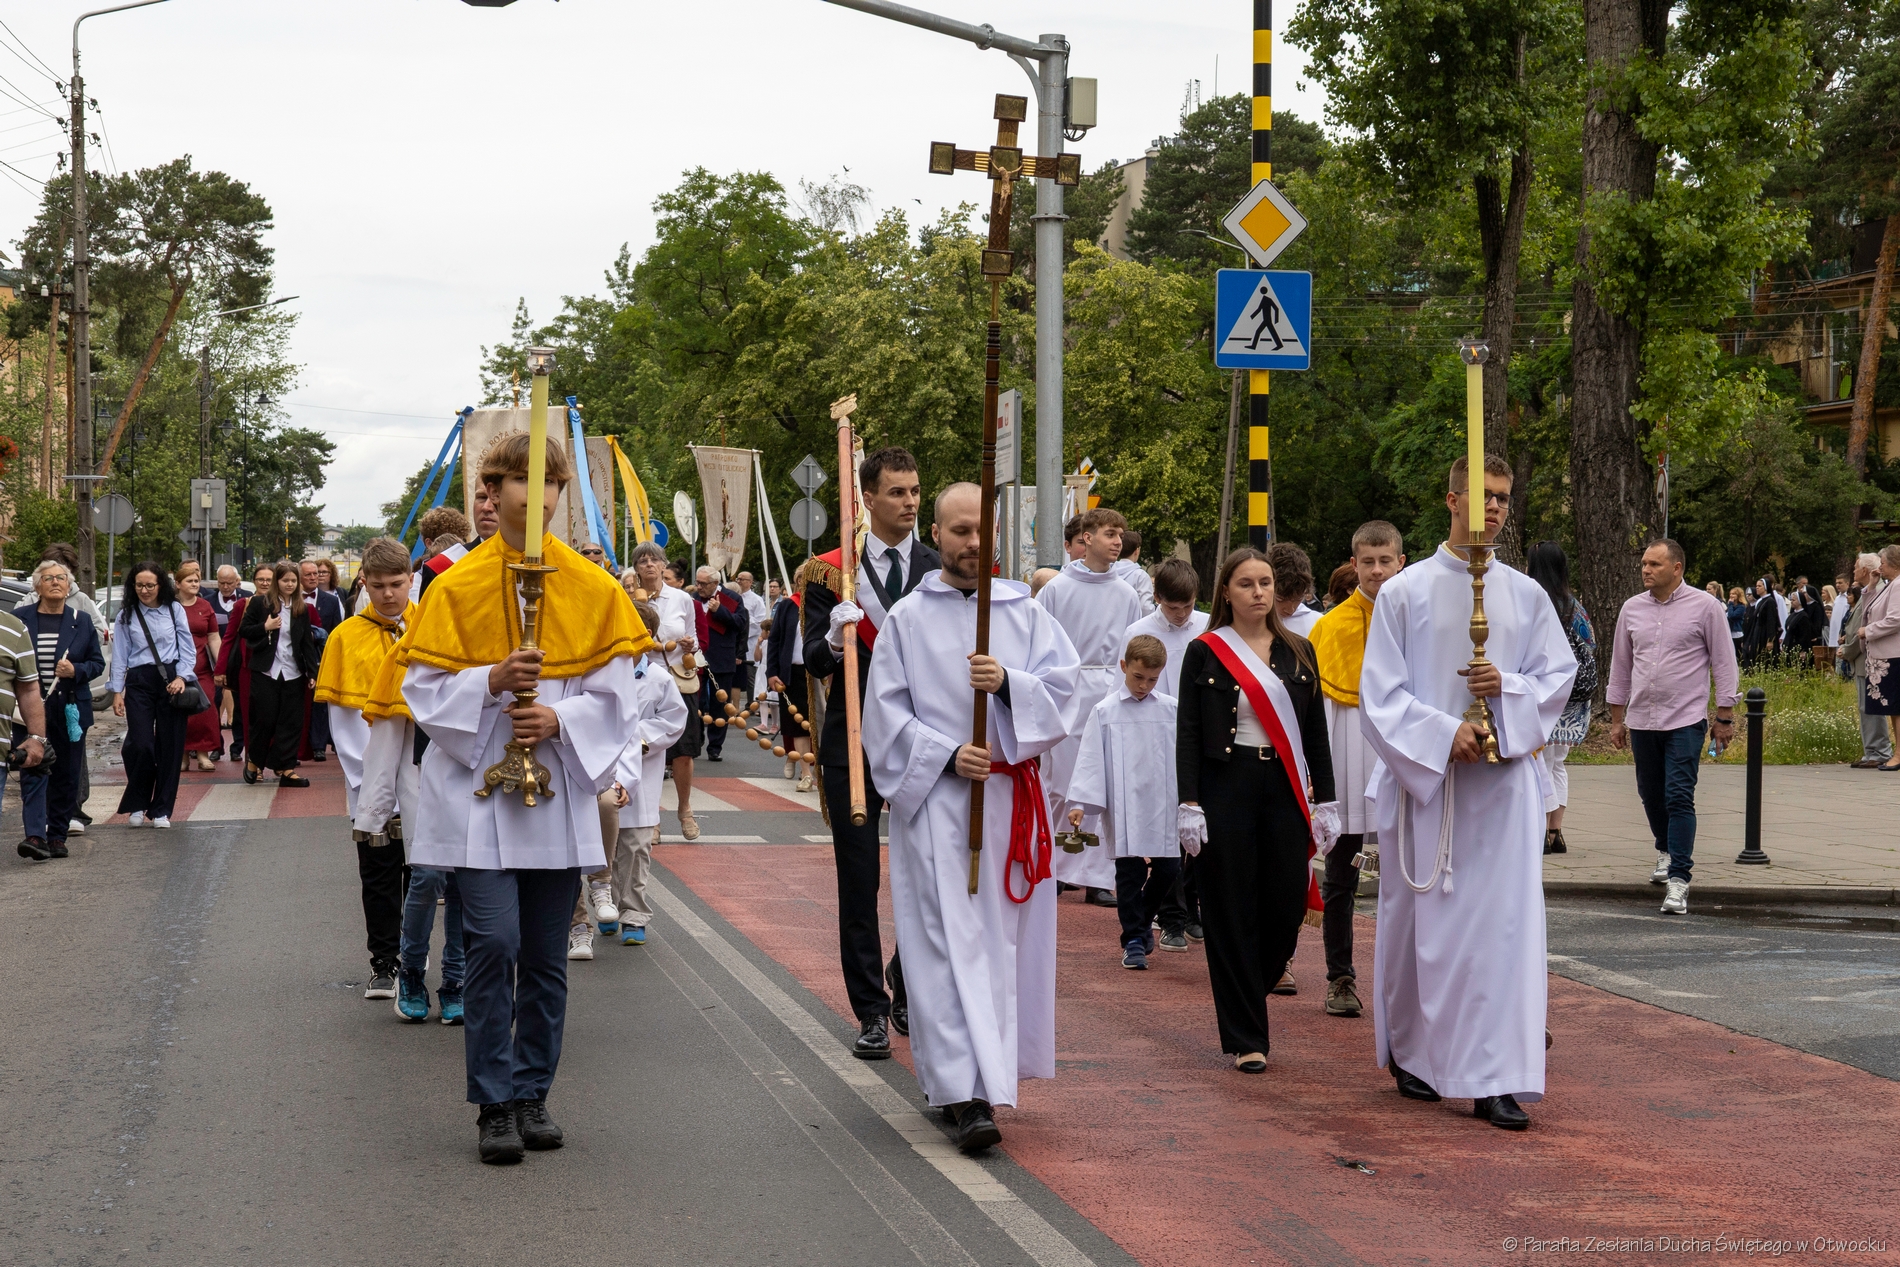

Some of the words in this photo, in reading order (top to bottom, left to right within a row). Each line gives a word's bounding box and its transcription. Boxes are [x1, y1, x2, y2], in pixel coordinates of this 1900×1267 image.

[475, 448, 489, 475] ATKO
[488, 431, 510, 447] BOŻA
[598, 457, 609, 493] CHRYSTUSA
